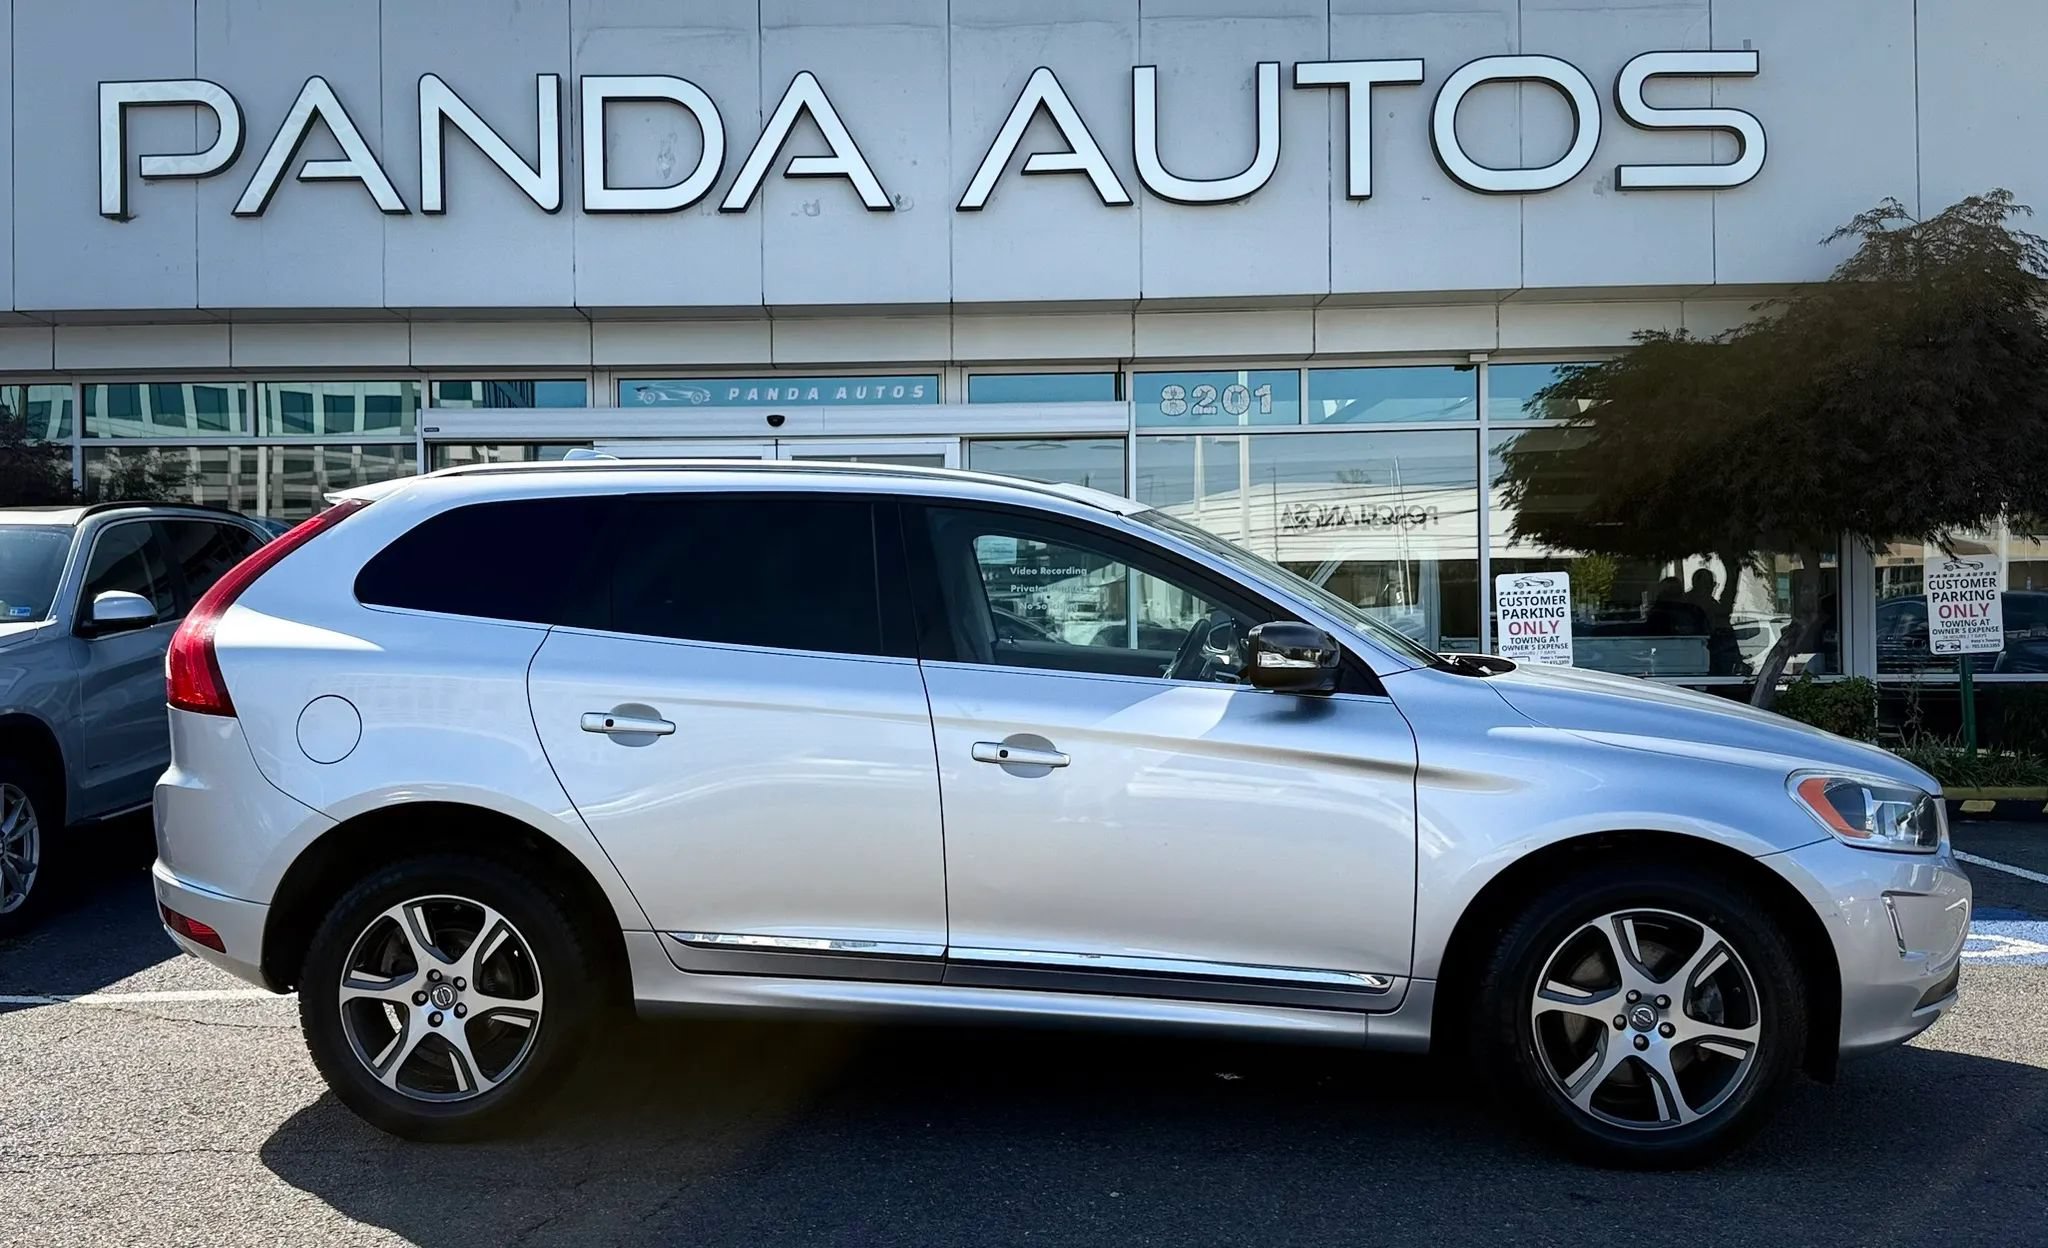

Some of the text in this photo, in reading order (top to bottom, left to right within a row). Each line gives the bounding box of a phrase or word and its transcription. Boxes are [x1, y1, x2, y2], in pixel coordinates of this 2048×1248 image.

[97, 49, 1768, 218] PANDA AUTOS
[728, 385, 924, 401] PANDA AUTOS
[1159, 383, 1273, 416] 8201
[1010, 566, 1087, 577] Video Recording
[1928, 577, 1997, 590] CUSTOMER
[1499, 595, 1567, 607] CUSTOMER
[1932, 590, 1995, 603] PARKING
[1502, 607, 1565, 620] PARKING
[1938, 603, 1990, 619] ONLY
[1508, 620, 1560, 636] ONLY
[1940, 620, 1977, 628] TOWING
[1932, 626, 2000, 636] OWNER'S EXPENSE
[1510, 637, 1547, 645] TOWING
[1501, 644, 1536, 652] OWNER'S
